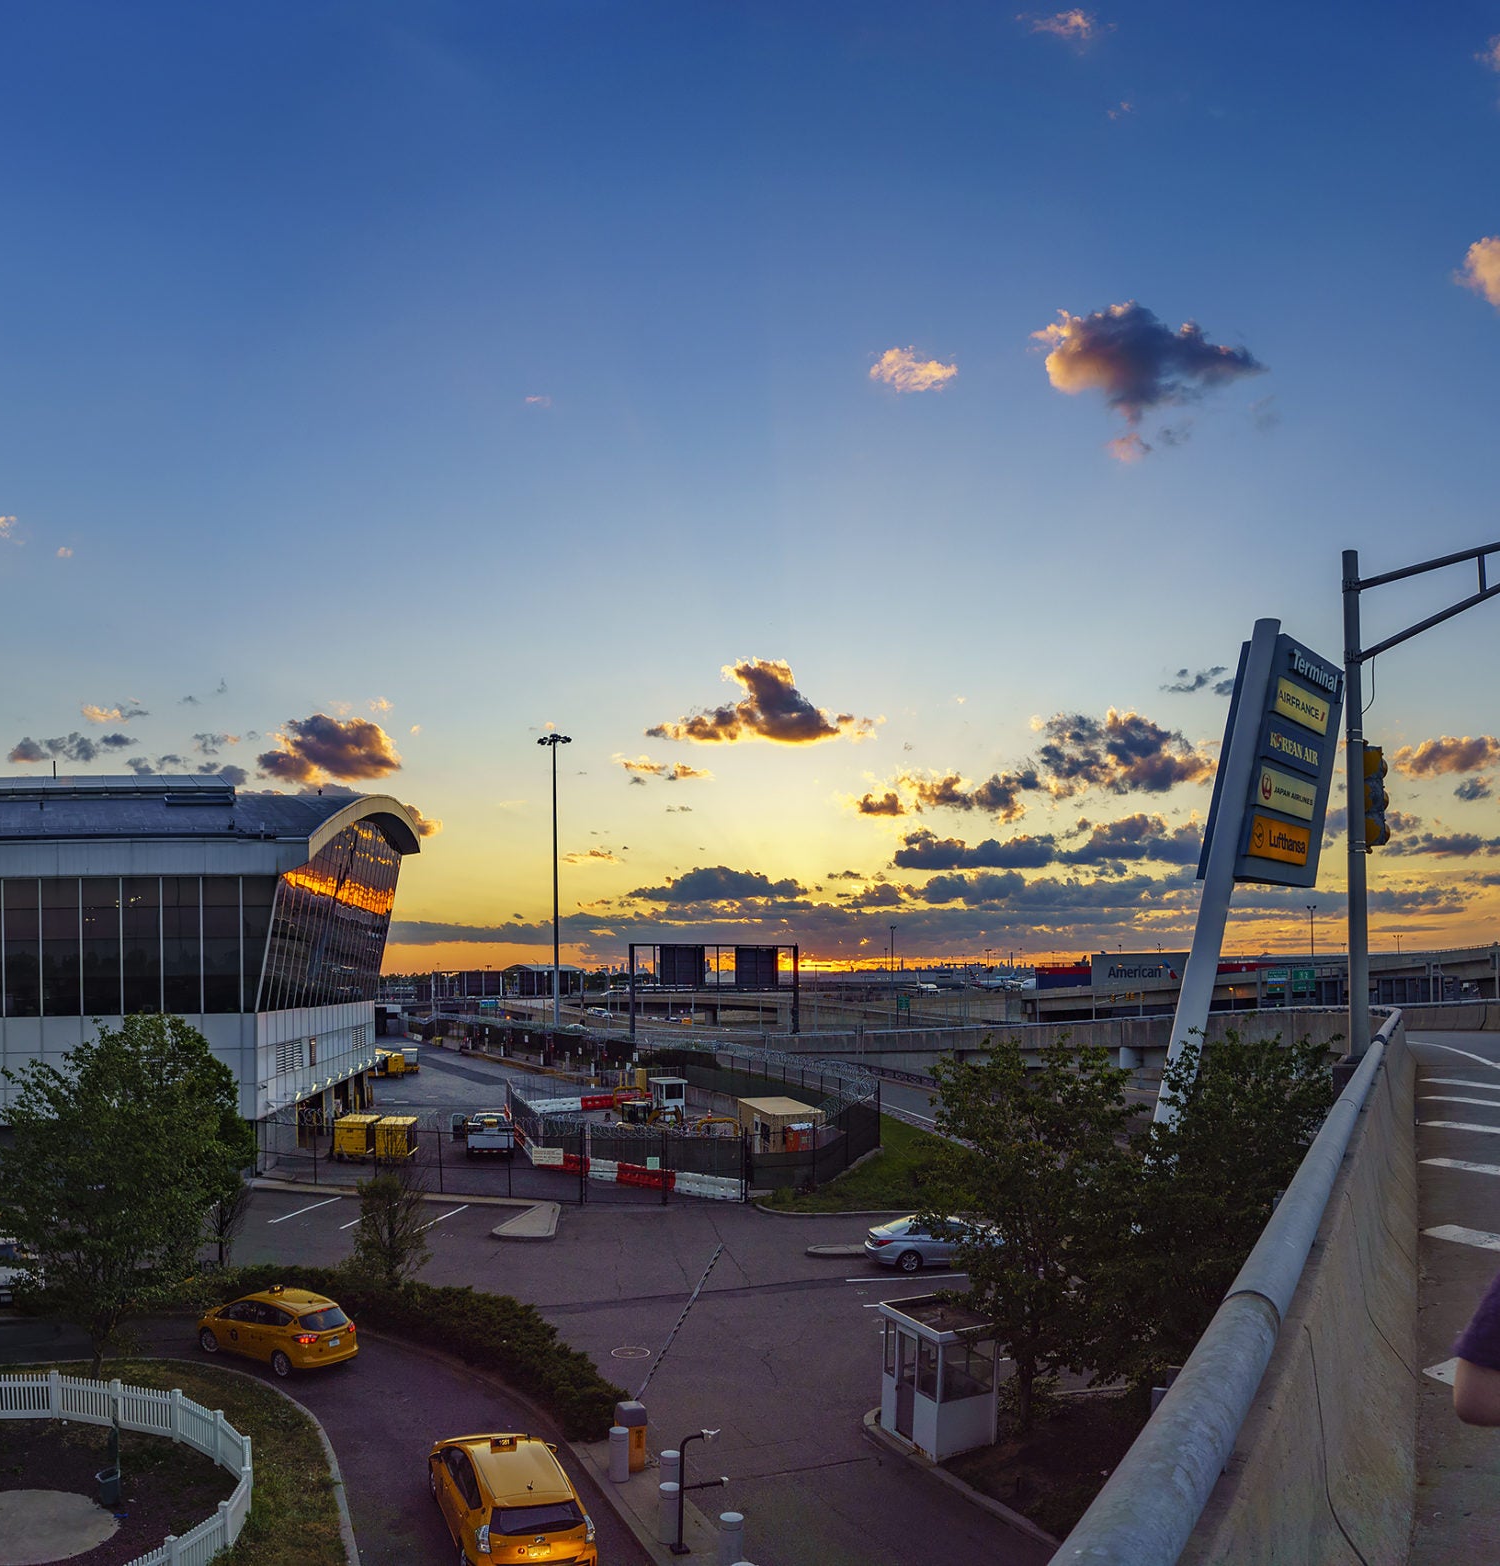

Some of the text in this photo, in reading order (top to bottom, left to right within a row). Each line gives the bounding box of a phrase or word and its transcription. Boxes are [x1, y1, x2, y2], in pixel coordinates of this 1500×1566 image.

[1293, 648, 1338, 693] Terminal
[1269, 732, 1319, 766] KOREAN AIR
[1273, 786, 1313, 806] JAPAN AIRLINES
[1269, 830, 1306, 854] Lufthansa
[1107, 965, 1162, 979] American
